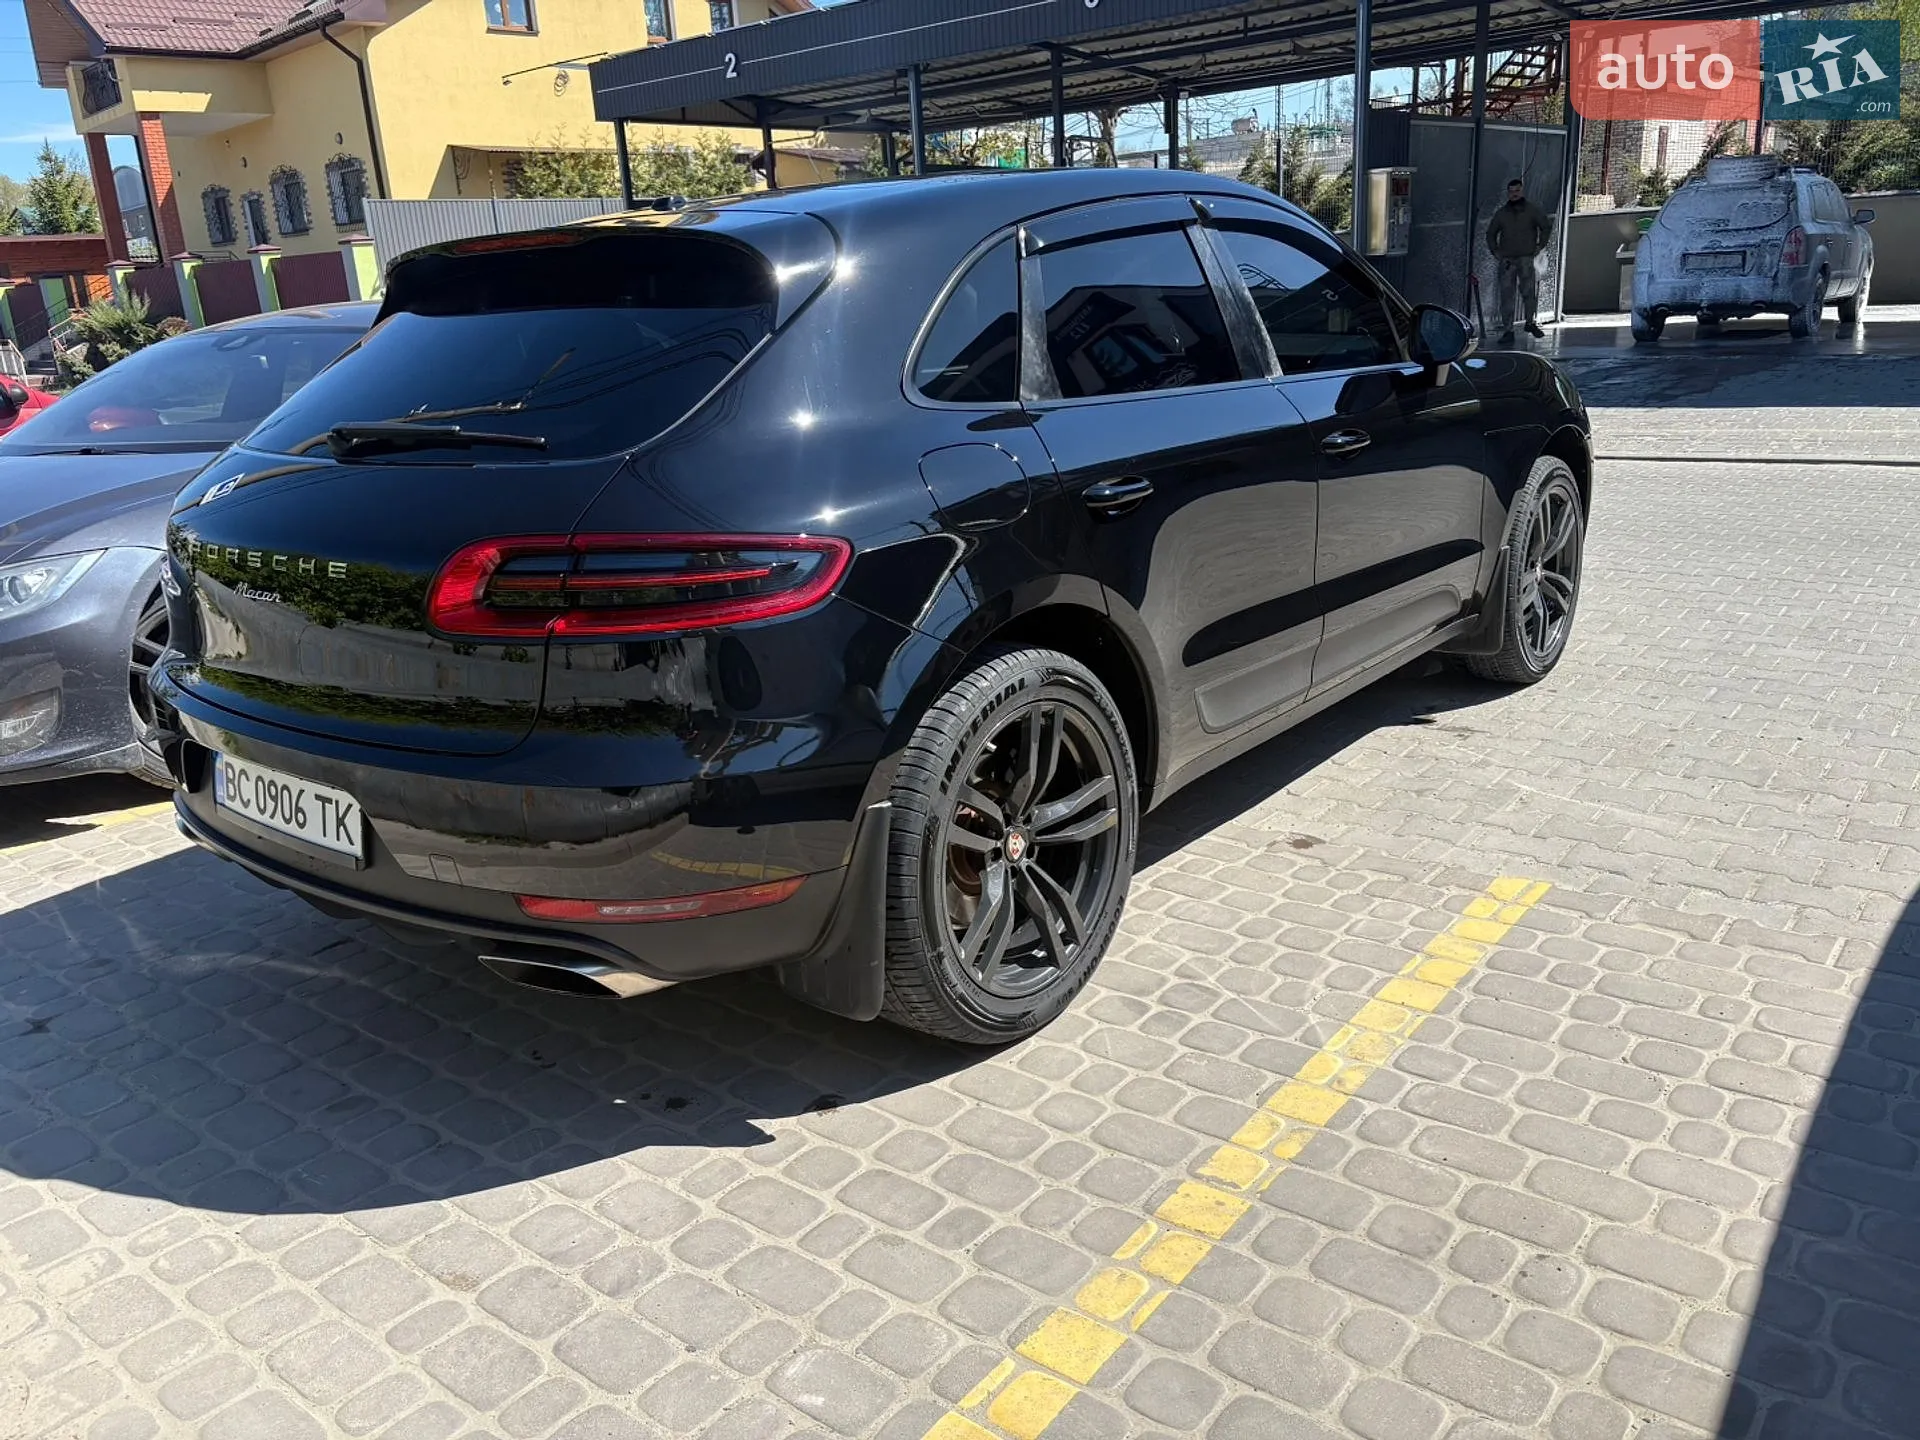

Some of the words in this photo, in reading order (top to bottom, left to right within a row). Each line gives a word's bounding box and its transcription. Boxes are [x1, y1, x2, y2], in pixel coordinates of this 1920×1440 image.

[725, 52, 737, 78] 2
[188, 542, 349, 579] PORSCHE
[234, 581, 281, 603] Macan
[940, 677, 1028, 796] IMPERIAL
[224, 761, 251, 809] BC
[255, 775, 307, 830] 0906
[315, 793, 355, 846] TK
